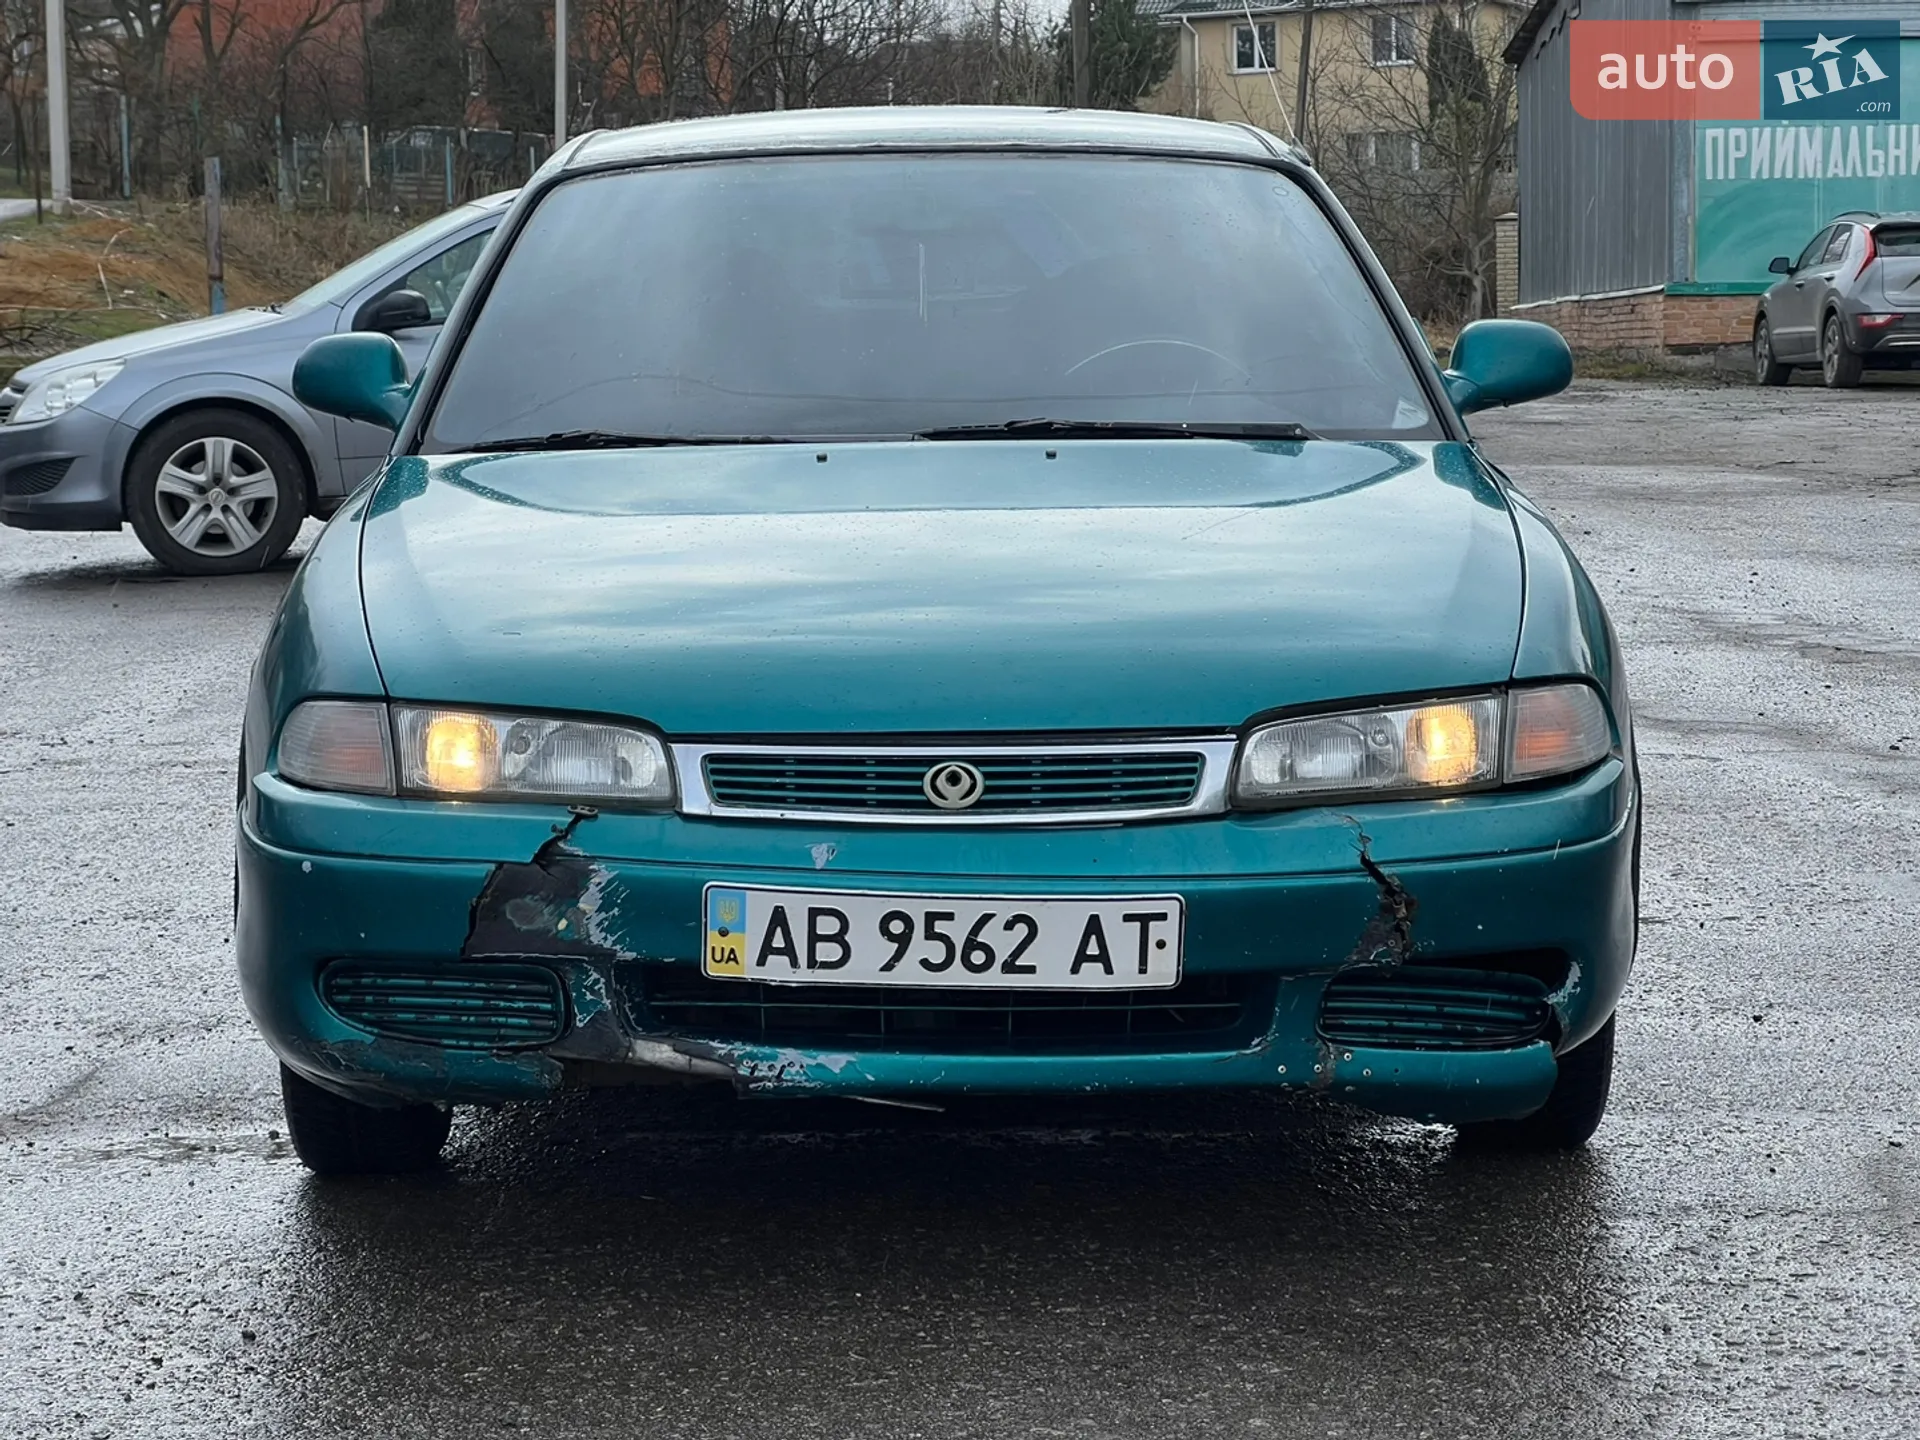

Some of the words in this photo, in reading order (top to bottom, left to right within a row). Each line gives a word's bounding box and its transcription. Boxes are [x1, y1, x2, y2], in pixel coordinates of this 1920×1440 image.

[711, 946, 739, 965] UA
[755, 904, 852, 971] AB
[877, 909, 1039, 975] 9562
[1069, 912, 1168, 975] AT
